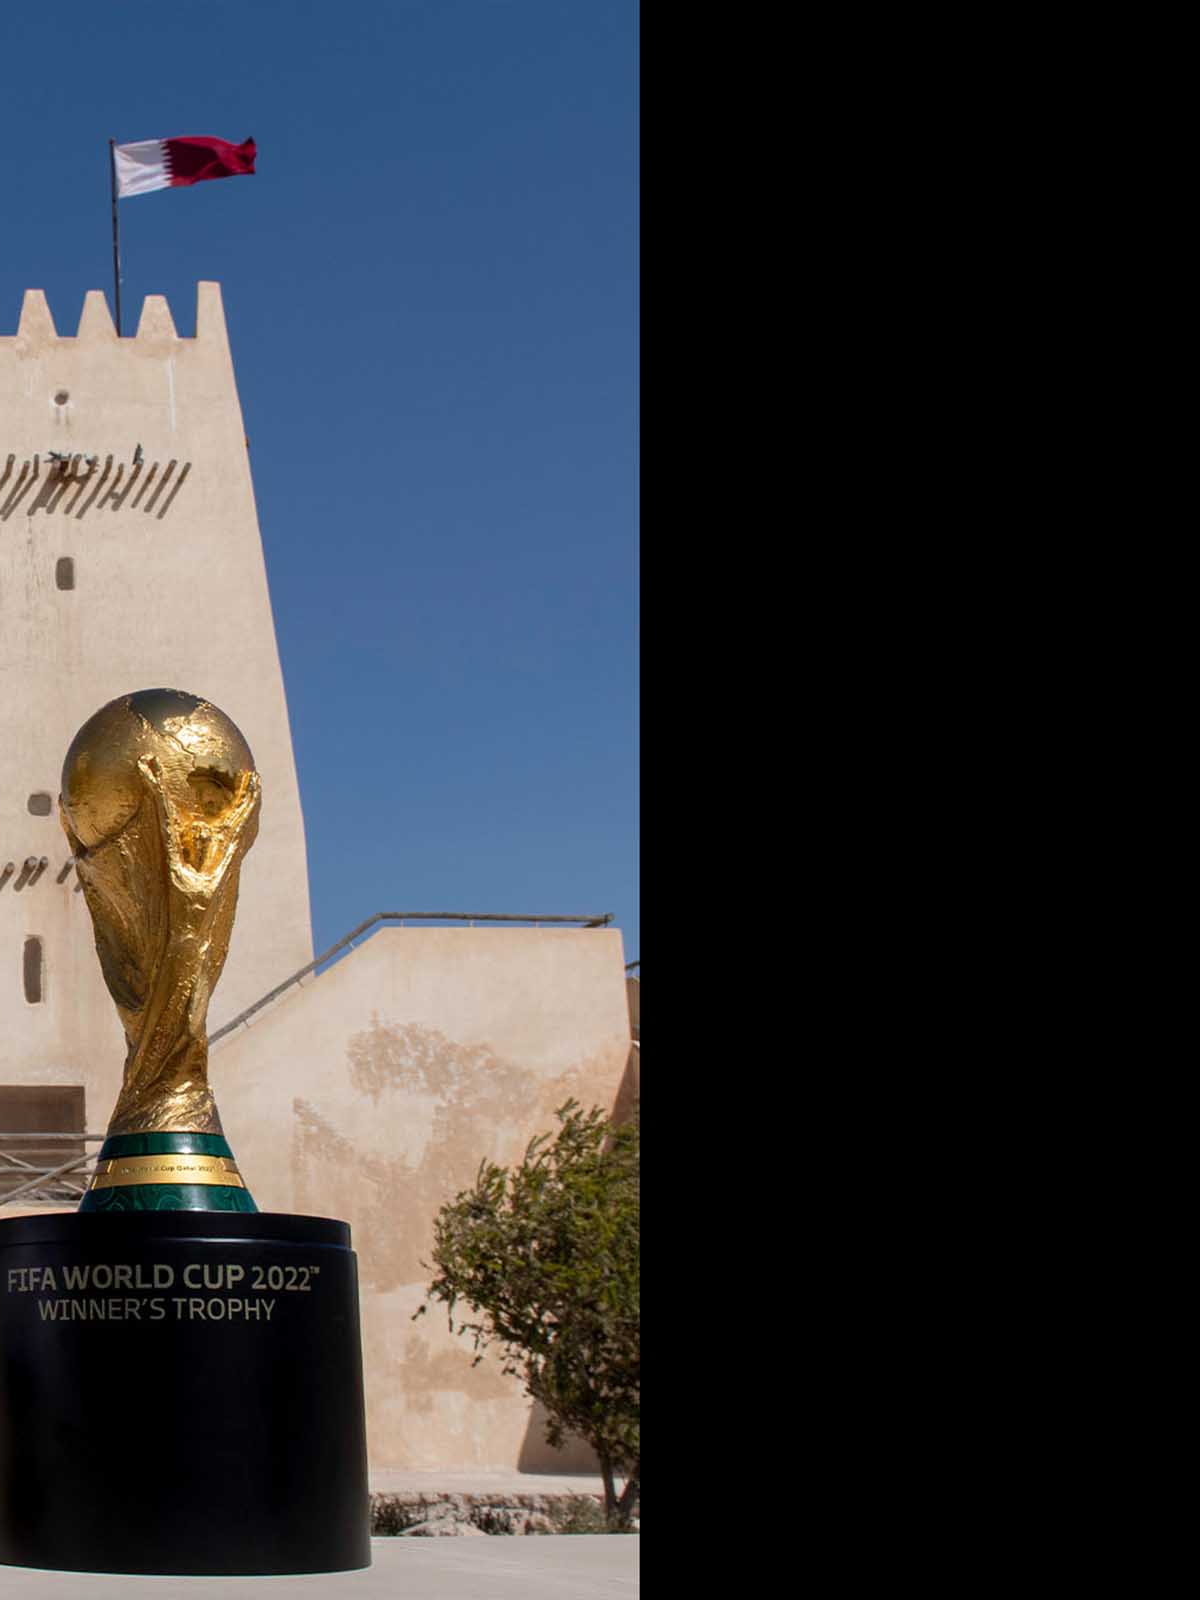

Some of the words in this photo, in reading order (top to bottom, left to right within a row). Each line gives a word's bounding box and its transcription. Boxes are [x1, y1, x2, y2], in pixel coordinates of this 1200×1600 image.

[7, 1266, 57, 1292] FIFA
[62, 1265, 175, 1290] WORLD
[183, 1264, 245, 1290] CUP
[172, 1298, 276, 1321] TROPHY
